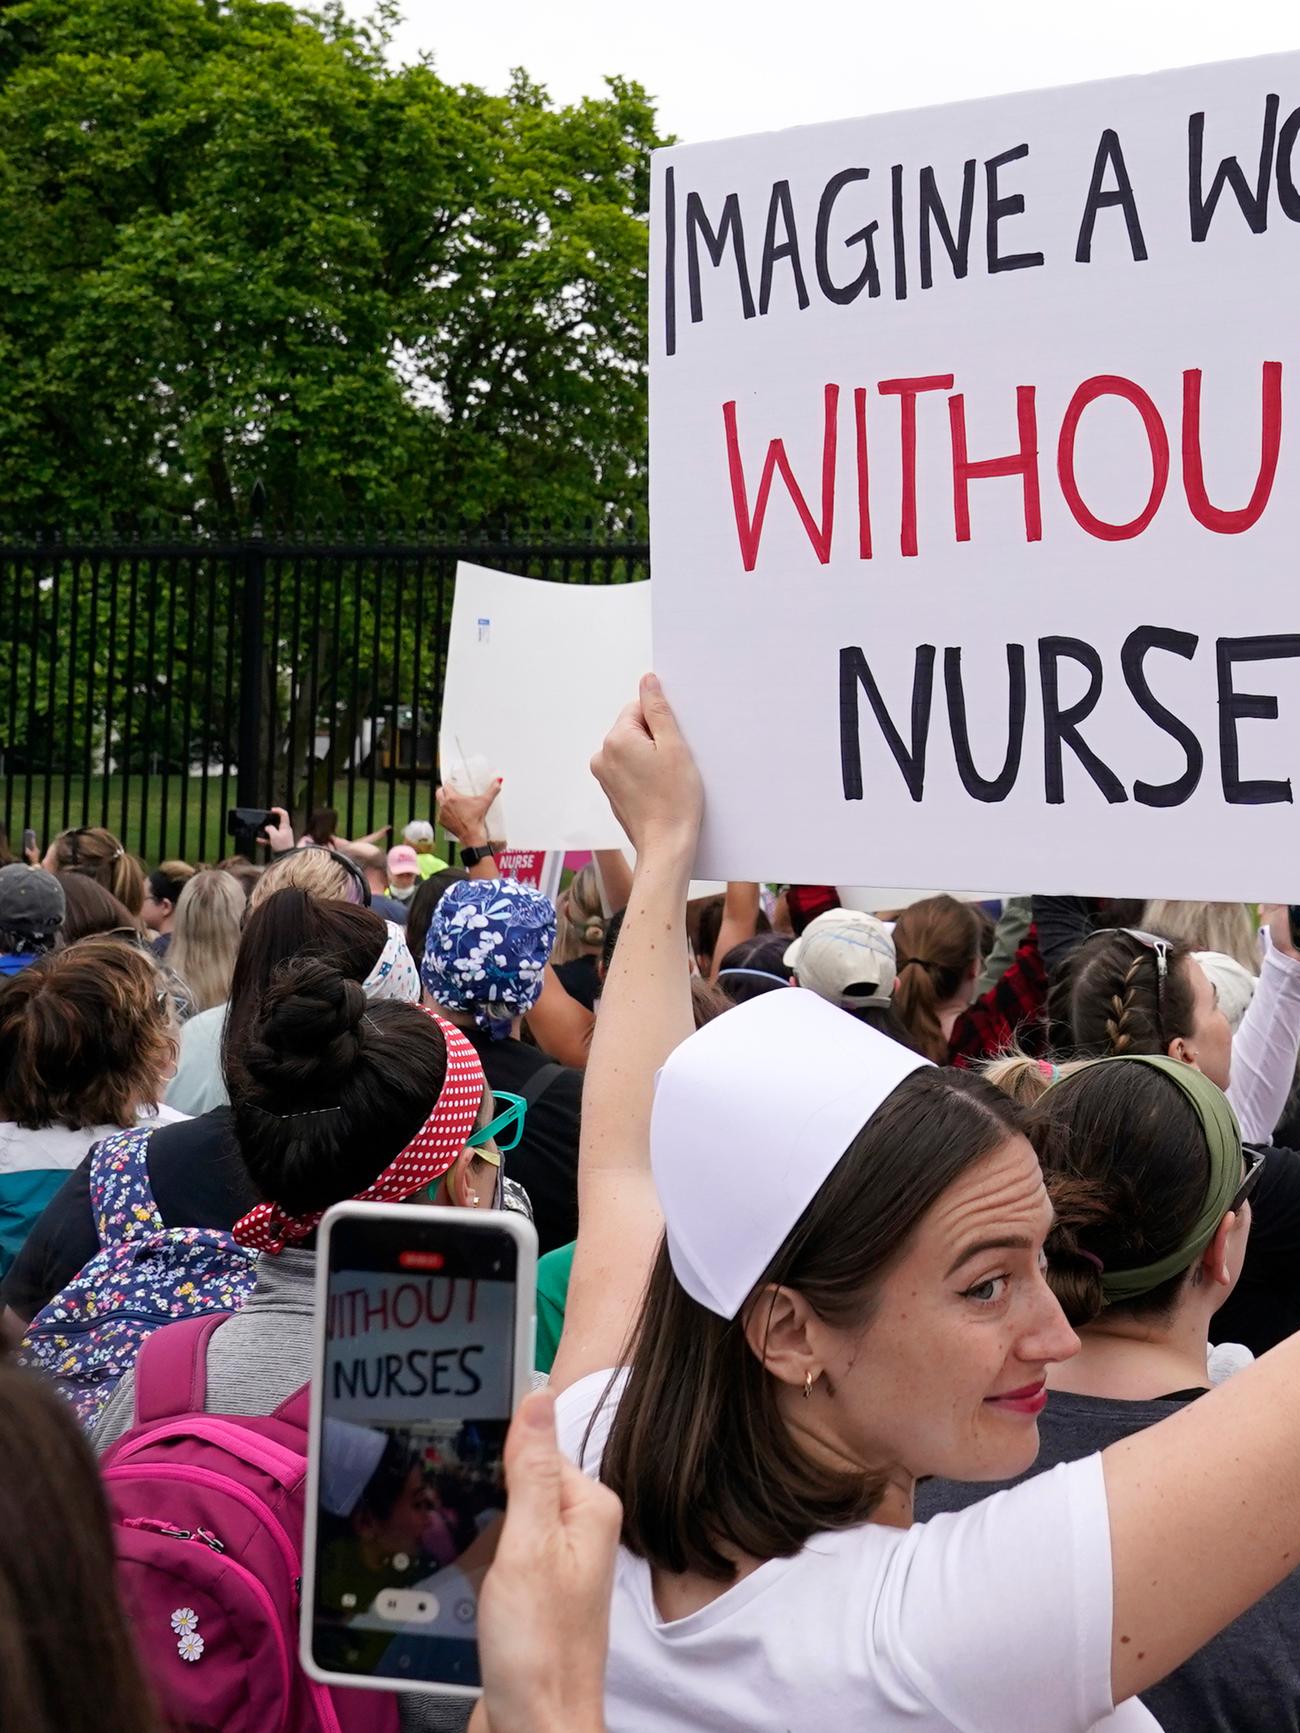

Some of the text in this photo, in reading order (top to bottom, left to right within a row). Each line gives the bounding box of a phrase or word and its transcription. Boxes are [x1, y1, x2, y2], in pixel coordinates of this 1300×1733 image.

[666, 144, 1044, 355] IMAGINE
[1076, 129, 1148, 263] A
[499, 854, 535, 869] NURSE
[334, 1345, 484, 1399] NURSES
